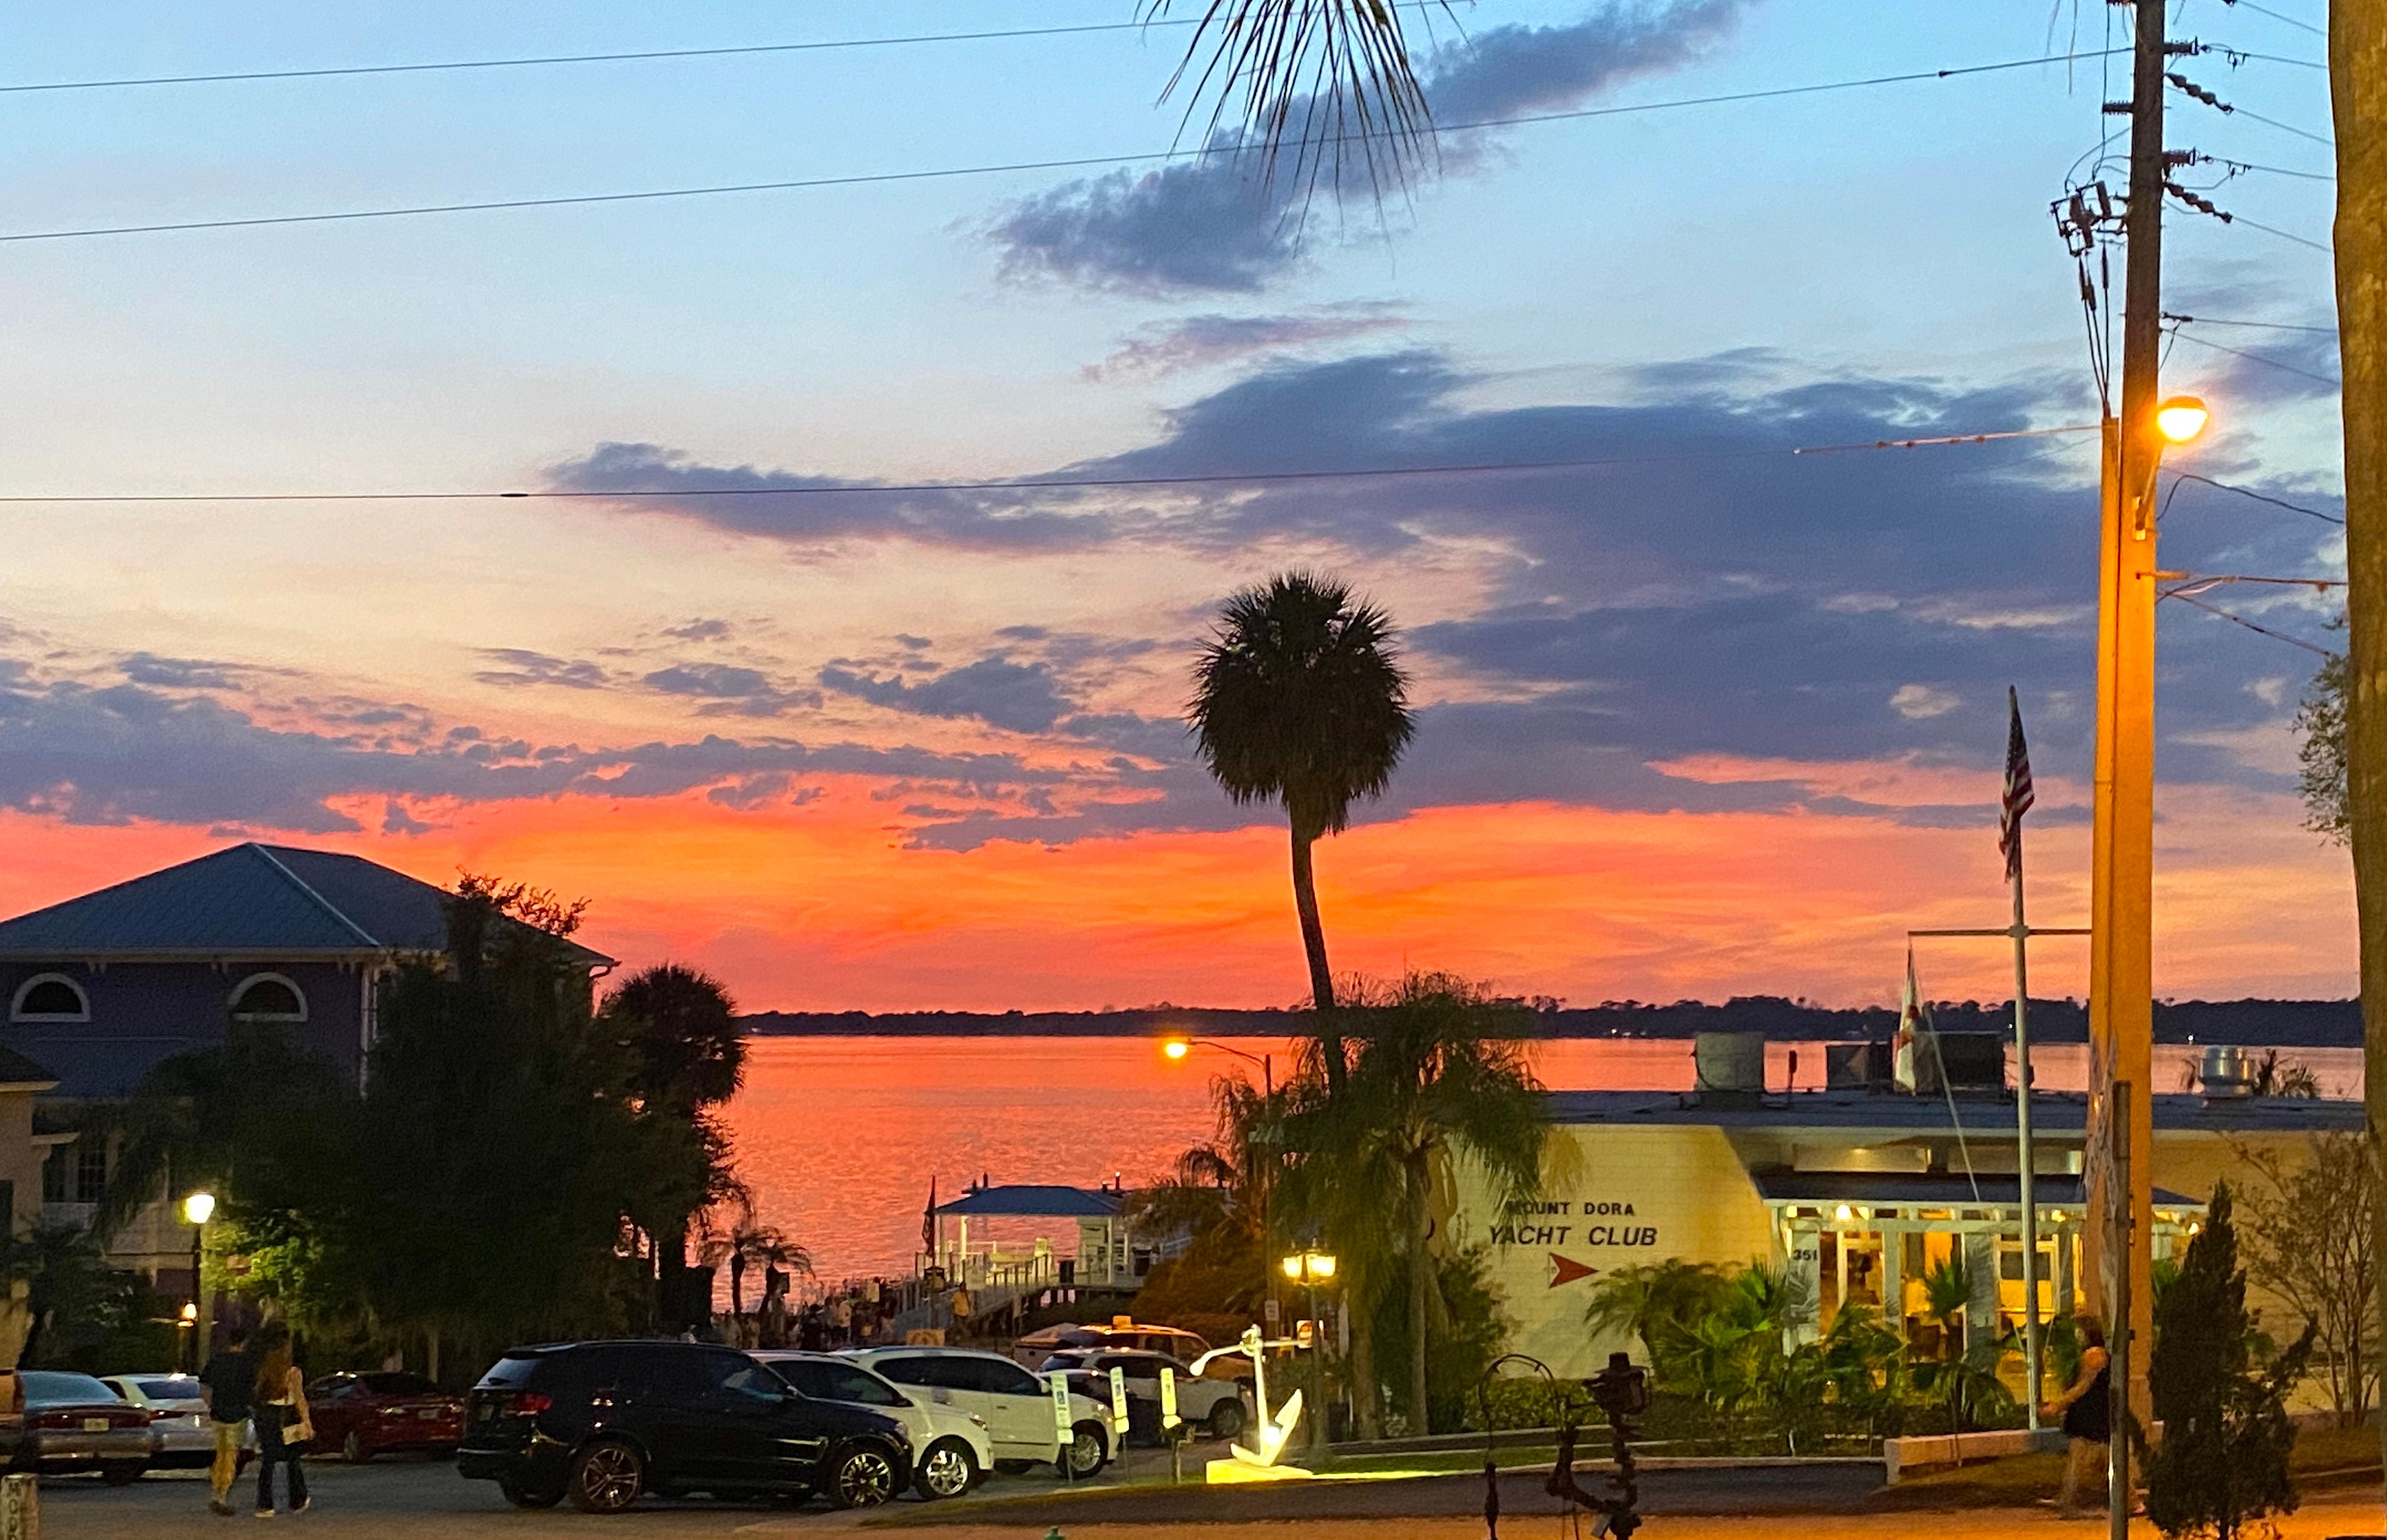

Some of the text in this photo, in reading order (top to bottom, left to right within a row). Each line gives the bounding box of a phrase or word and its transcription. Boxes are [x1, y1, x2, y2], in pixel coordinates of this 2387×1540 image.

[1584, 1202, 1635, 1216] DORA
[1489, 1225, 1658, 1246] YACHT CLUB
[1793, 1249, 1818, 1261] 351
